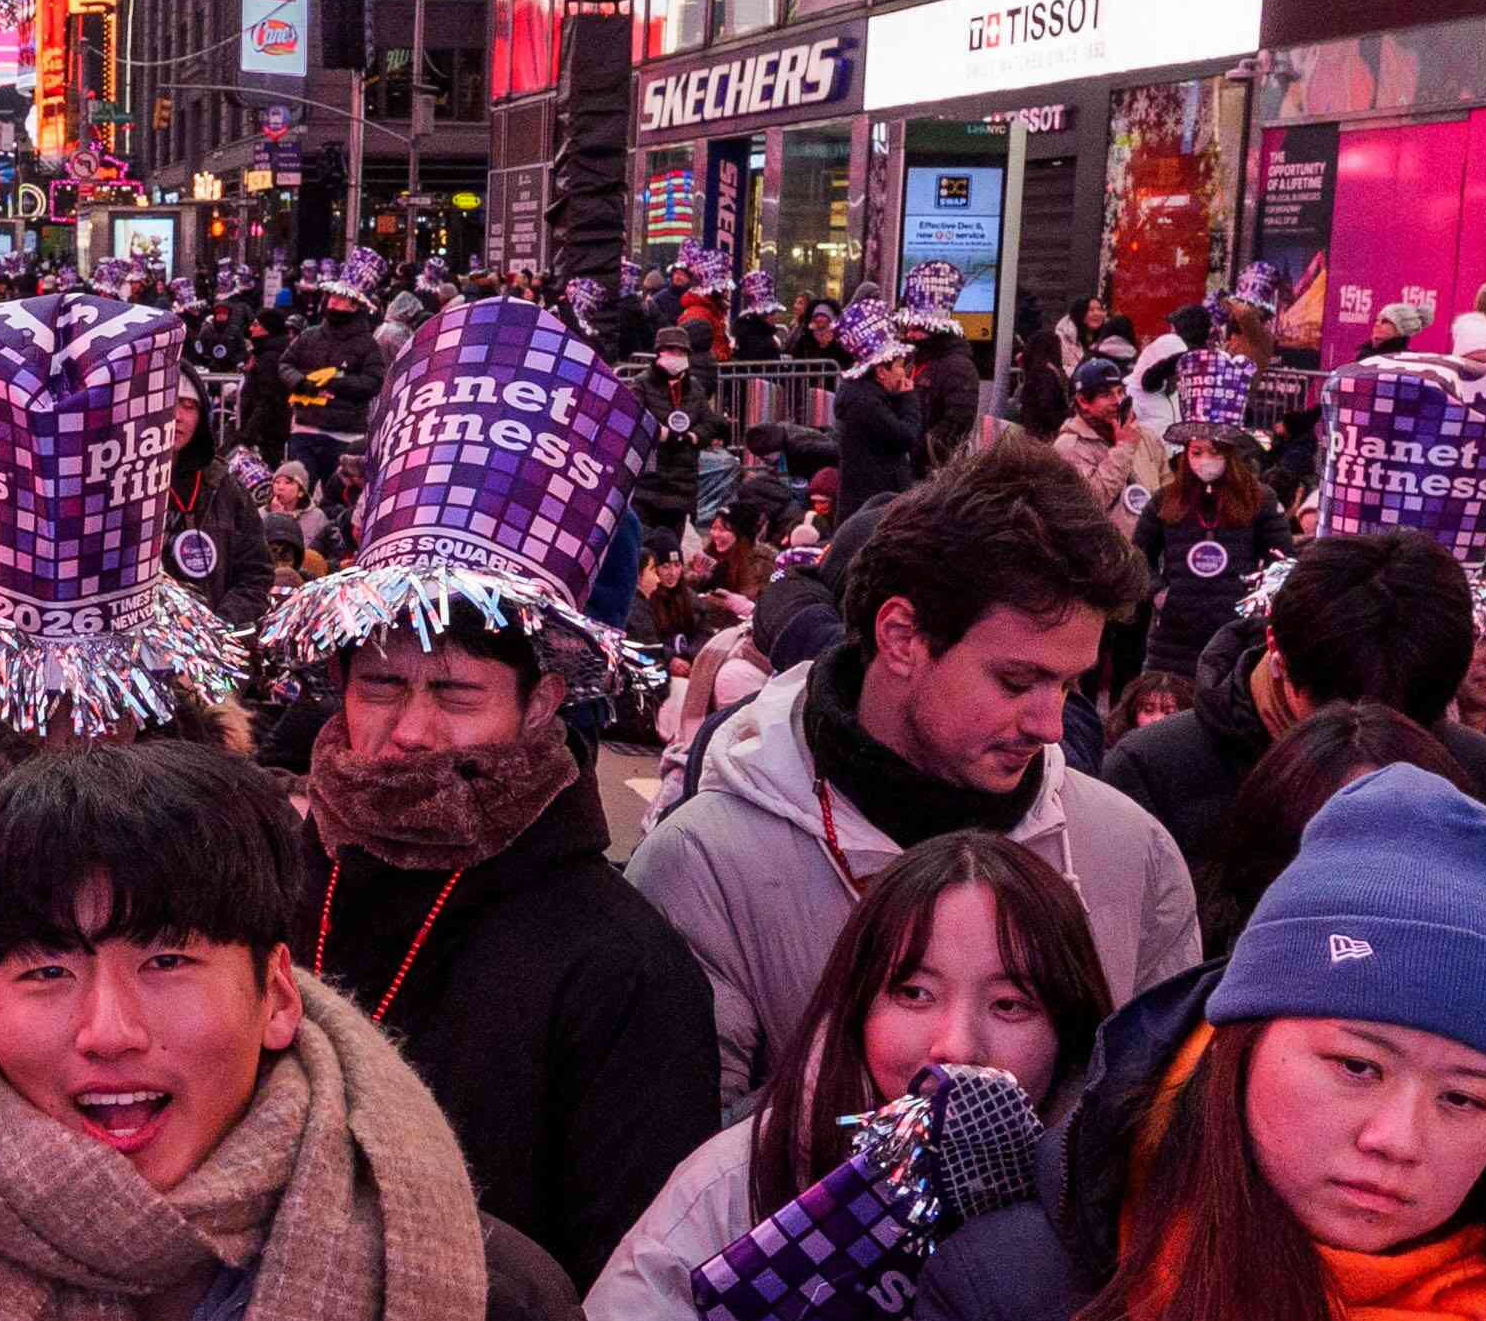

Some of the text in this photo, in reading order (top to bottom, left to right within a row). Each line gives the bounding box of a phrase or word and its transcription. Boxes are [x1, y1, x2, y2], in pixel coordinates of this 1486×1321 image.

[640, 38, 839, 130] SKECHERS
[1268, 162, 1326, 177] OPPORTUNITY
[1340, 286, 1372, 311] 1515
[379, 371, 577, 442] planet
[380, 413, 605, 491] fitness
[1328, 433, 1477, 470] planet
[417, 536, 524, 574] SQUARE
